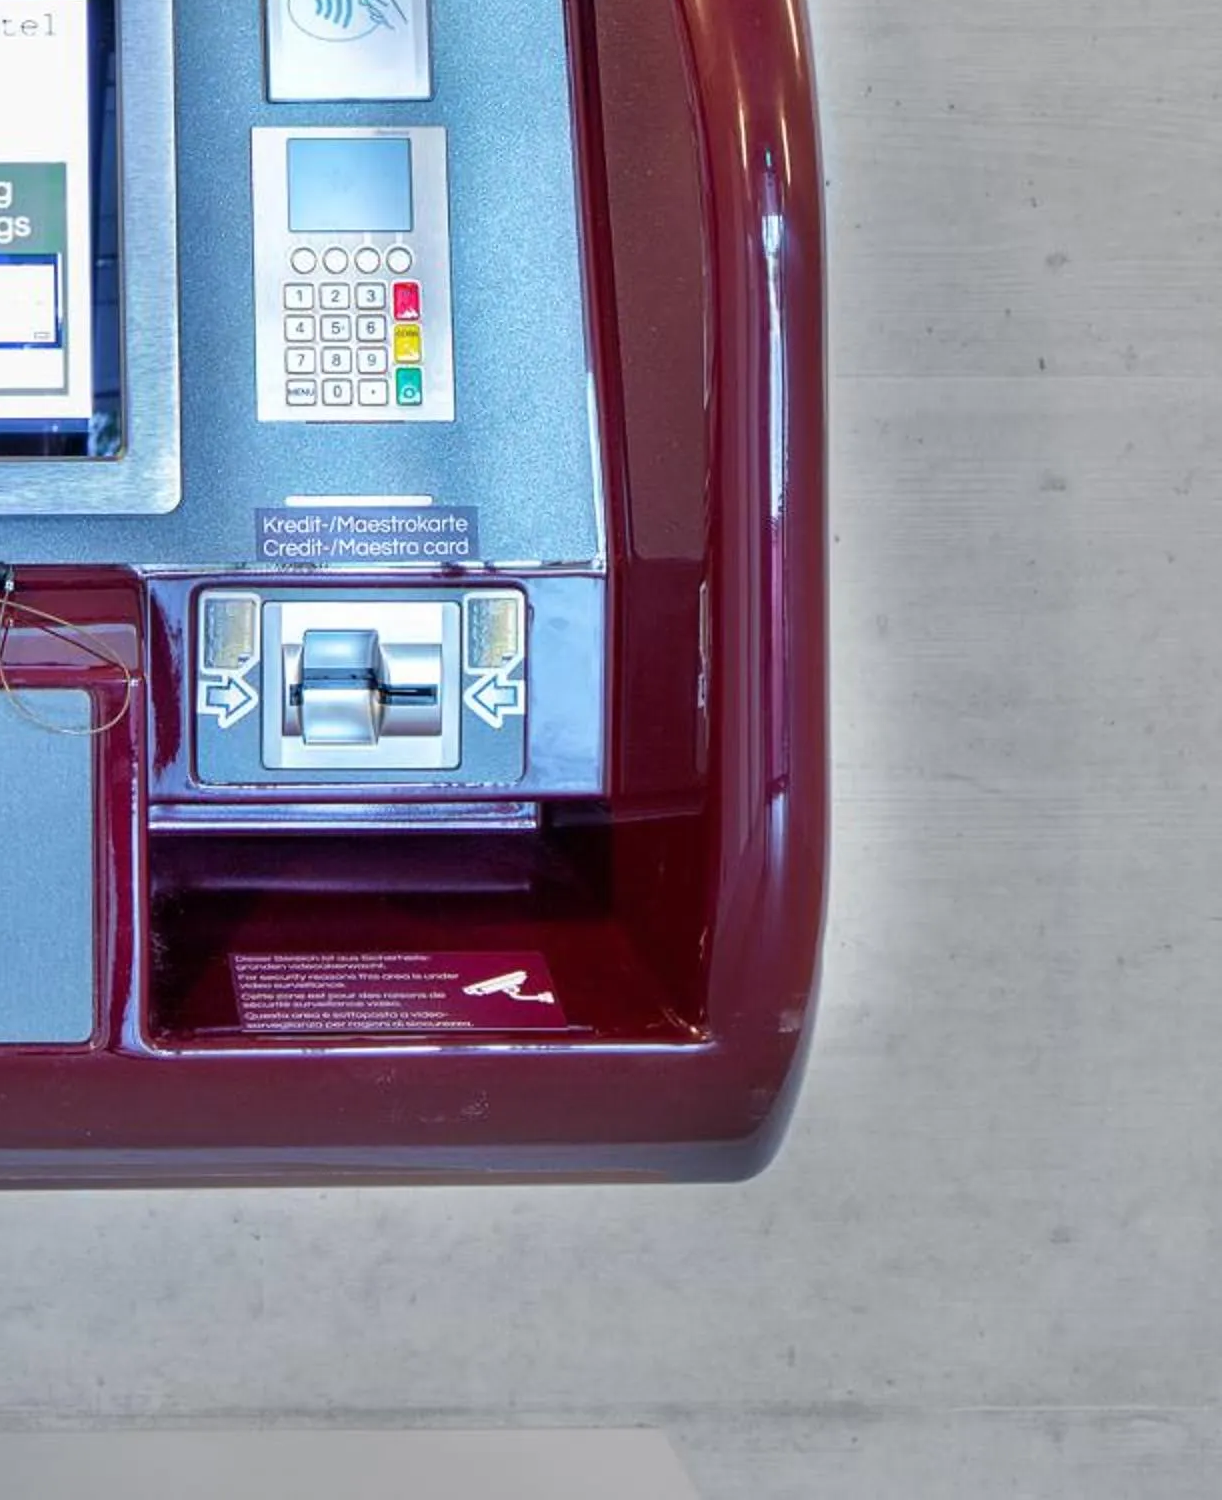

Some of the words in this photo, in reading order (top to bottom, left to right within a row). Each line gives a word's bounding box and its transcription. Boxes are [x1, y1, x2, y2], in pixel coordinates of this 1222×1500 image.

[331, 289, 340, 303] 2
[366, 289, 376, 303] 3
[331, 321, 341, 335] 5
[366, 321, 376, 335] 6
[331, 353, 341, 367] 8
[367, 353, 377, 367] 9
[263, 514, 468, 533] Kredit-/Maestrokarte
[263, 538, 419, 557] Credit-/Maestro
[423, 538, 469, 555] card
